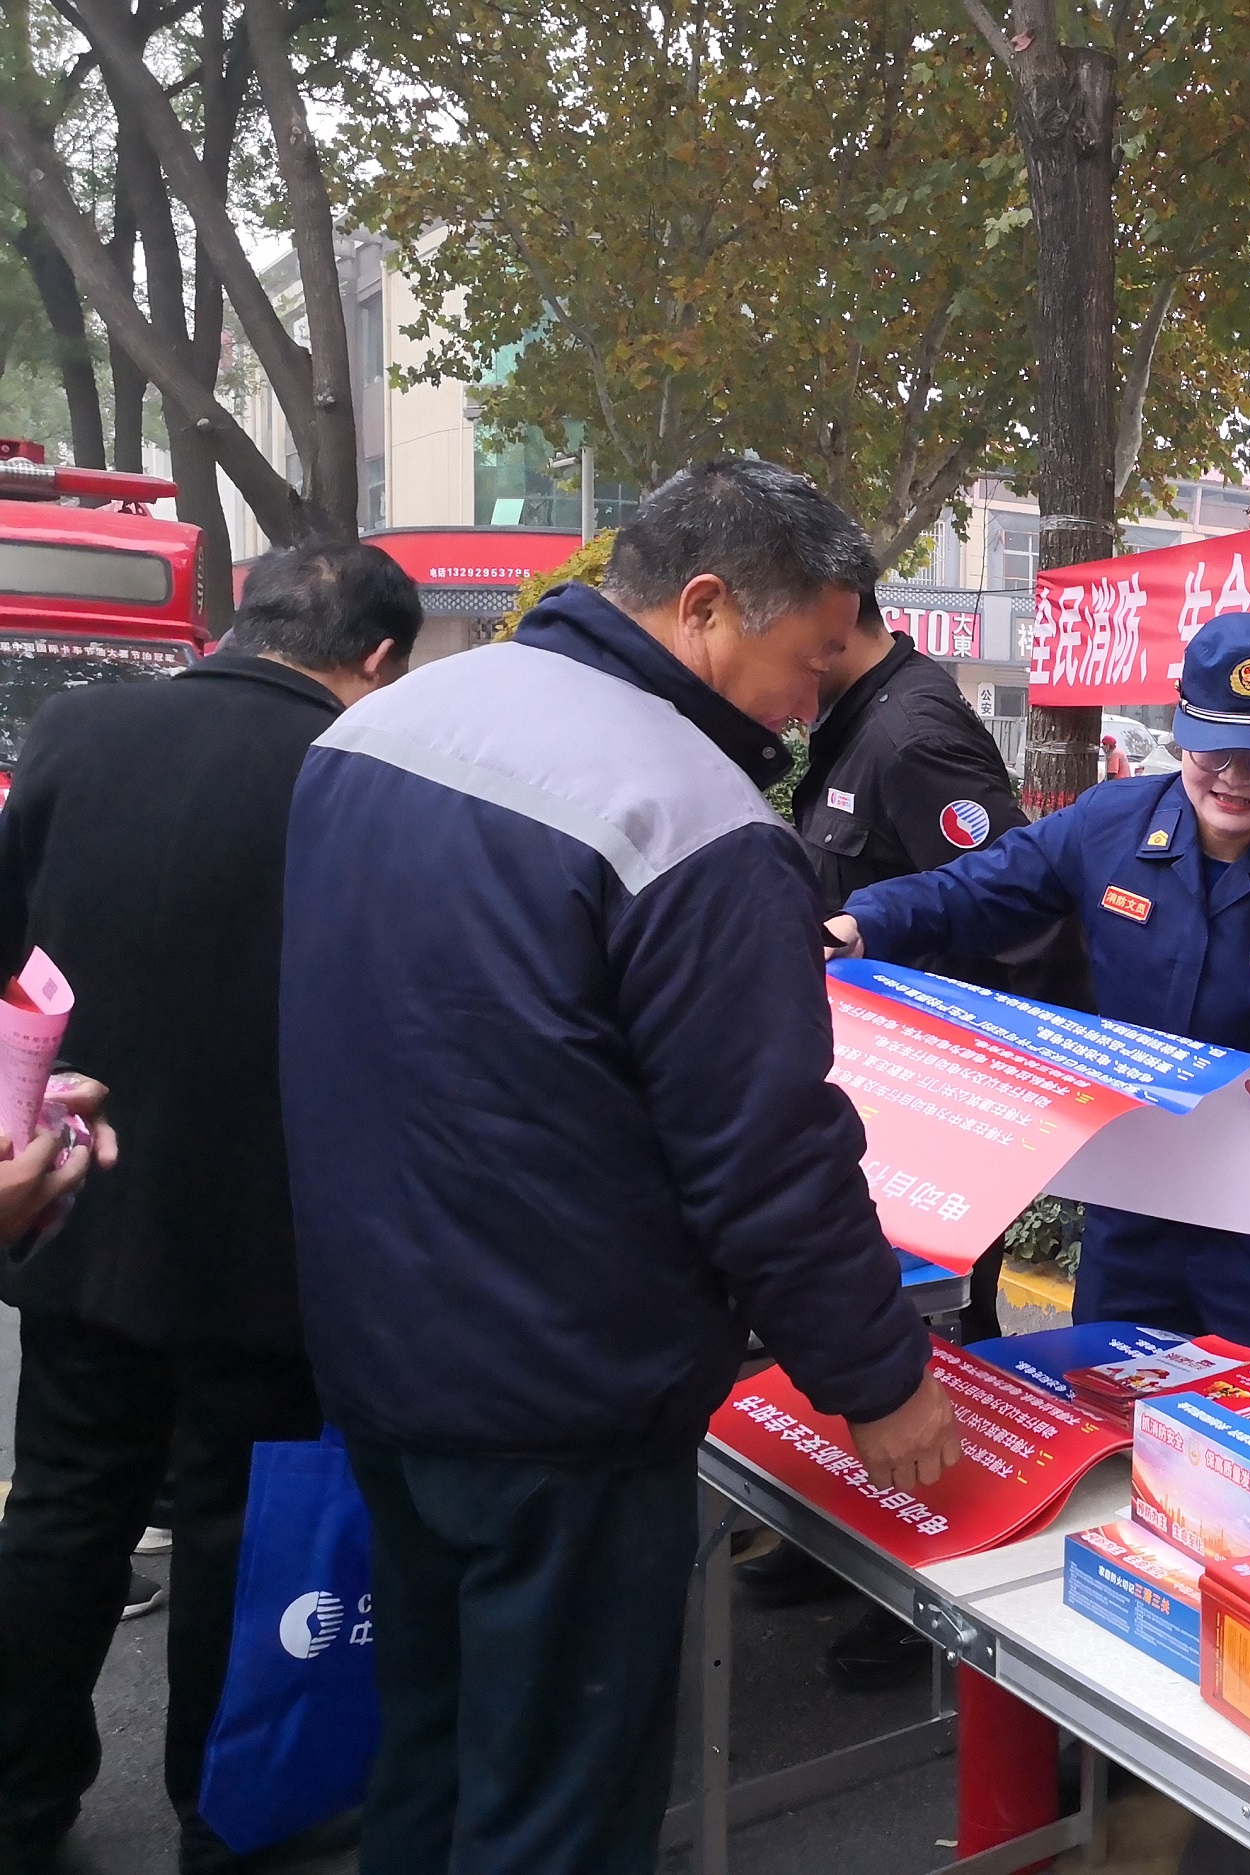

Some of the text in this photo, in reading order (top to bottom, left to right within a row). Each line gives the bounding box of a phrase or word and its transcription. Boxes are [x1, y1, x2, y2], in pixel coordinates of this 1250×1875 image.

[980, 689, 992, 715] 公安
[1105, 891, 1147, 916] 消防文员
[828, 996, 1095, 1105] 三、不得私拉电线、电缆为电动汽车、电动自行车、
[875, 1034, 1053, 1109] 动自行车以及为电动自行车充电。
[1037, 1026, 1155, 1083] 电动车、电池和充电器。
[834, 1043, 1058, 1134] 二、不得在建筑公共门厅、疏散走道、楼梯
[950, 1399, 1054, 1467] 二、不得在建筑公共门厅、
[1140, 1413, 1184, 1453] 抓消防安全
[733, 1395, 950, 1536] 电动自行车消防安全告知书
[1135, 1498, 1168, 1534] 预防为主
